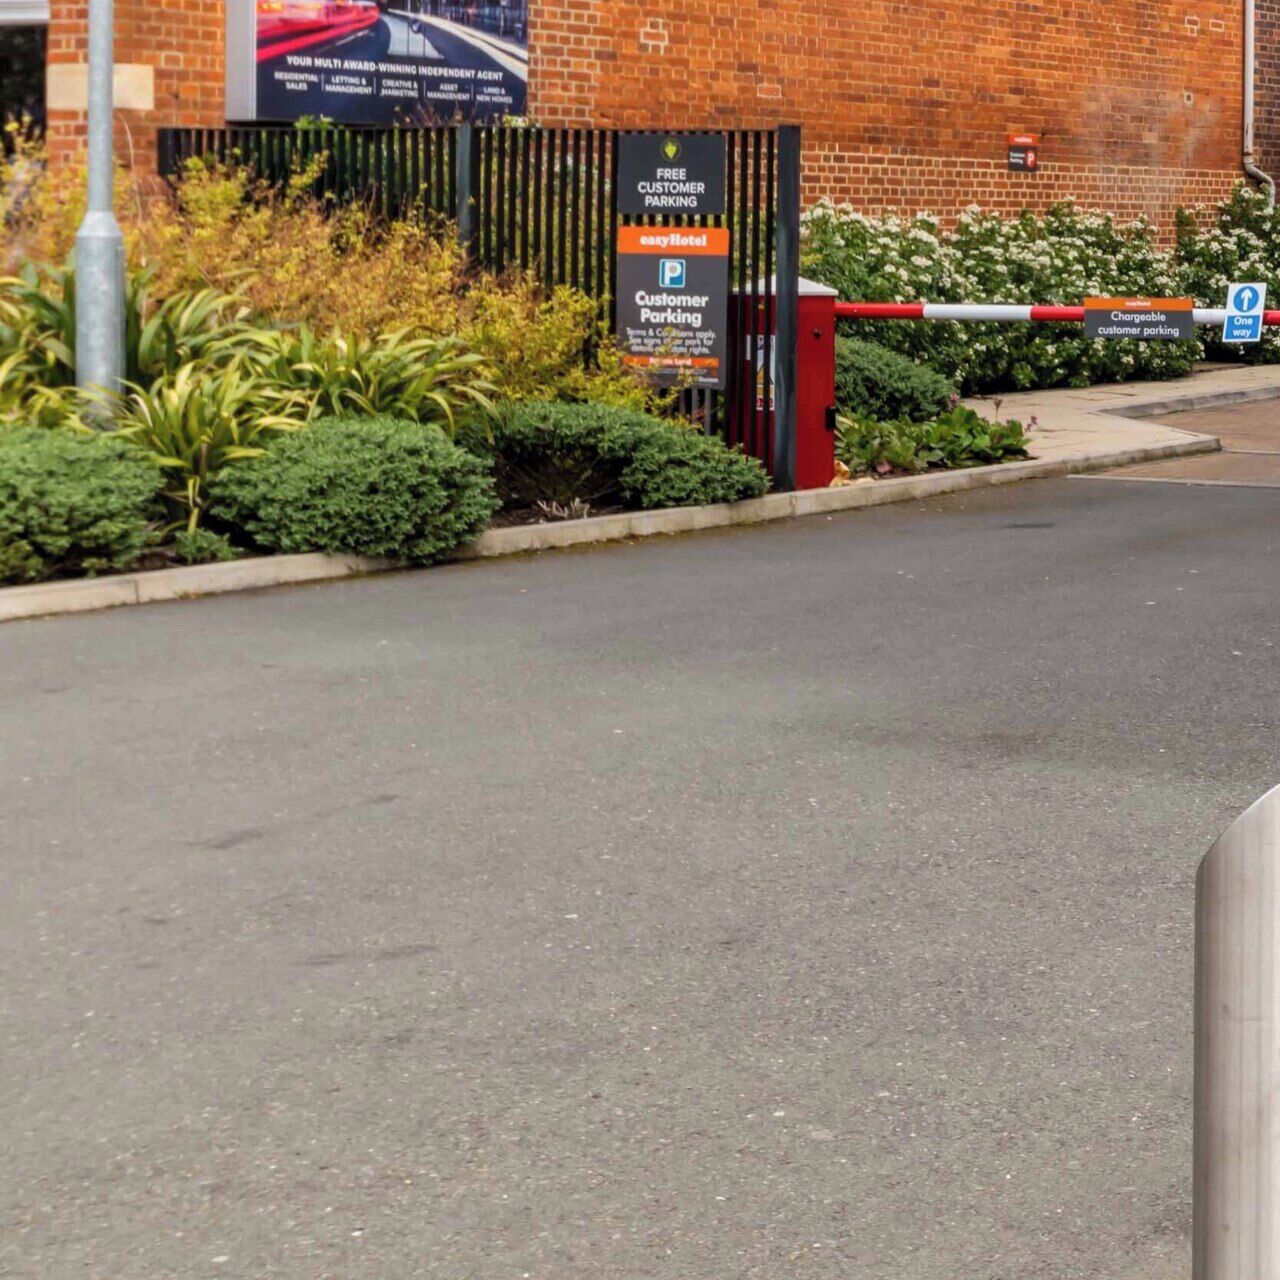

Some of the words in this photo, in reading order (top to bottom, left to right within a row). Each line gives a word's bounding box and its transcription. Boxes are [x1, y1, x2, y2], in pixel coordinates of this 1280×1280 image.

[287, 55, 312, 67] YOUR
[314, 57, 341, 68] MULTI
[343, 60, 416, 74] AWARD-WINNING
[418, 66, 475, 78] INDEPENDENT
[477, 70, 503, 80] AGENT
[274, 71, 318, 82] RESIDENTIAL
[325, 84, 372, 95] MANAGEMENT
[427, 91, 470, 100] MANAGEMENT
[656, 168, 687, 180] FREE
[637, 181, 705, 194] CUSTOMER
[645, 195, 698, 207] PARKING
[640, 233, 707, 248] easyHotel
[634, 290, 709, 307] Customer
[640, 308, 702, 328] Parking
[1111, 311, 1166, 323] Chargeable
[1233, 316, 1253, 326] One
[1098, 325, 1140, 335] customer
[1143, 325, 1179, 337] parking
[1232, 329, 1251, 338] way
